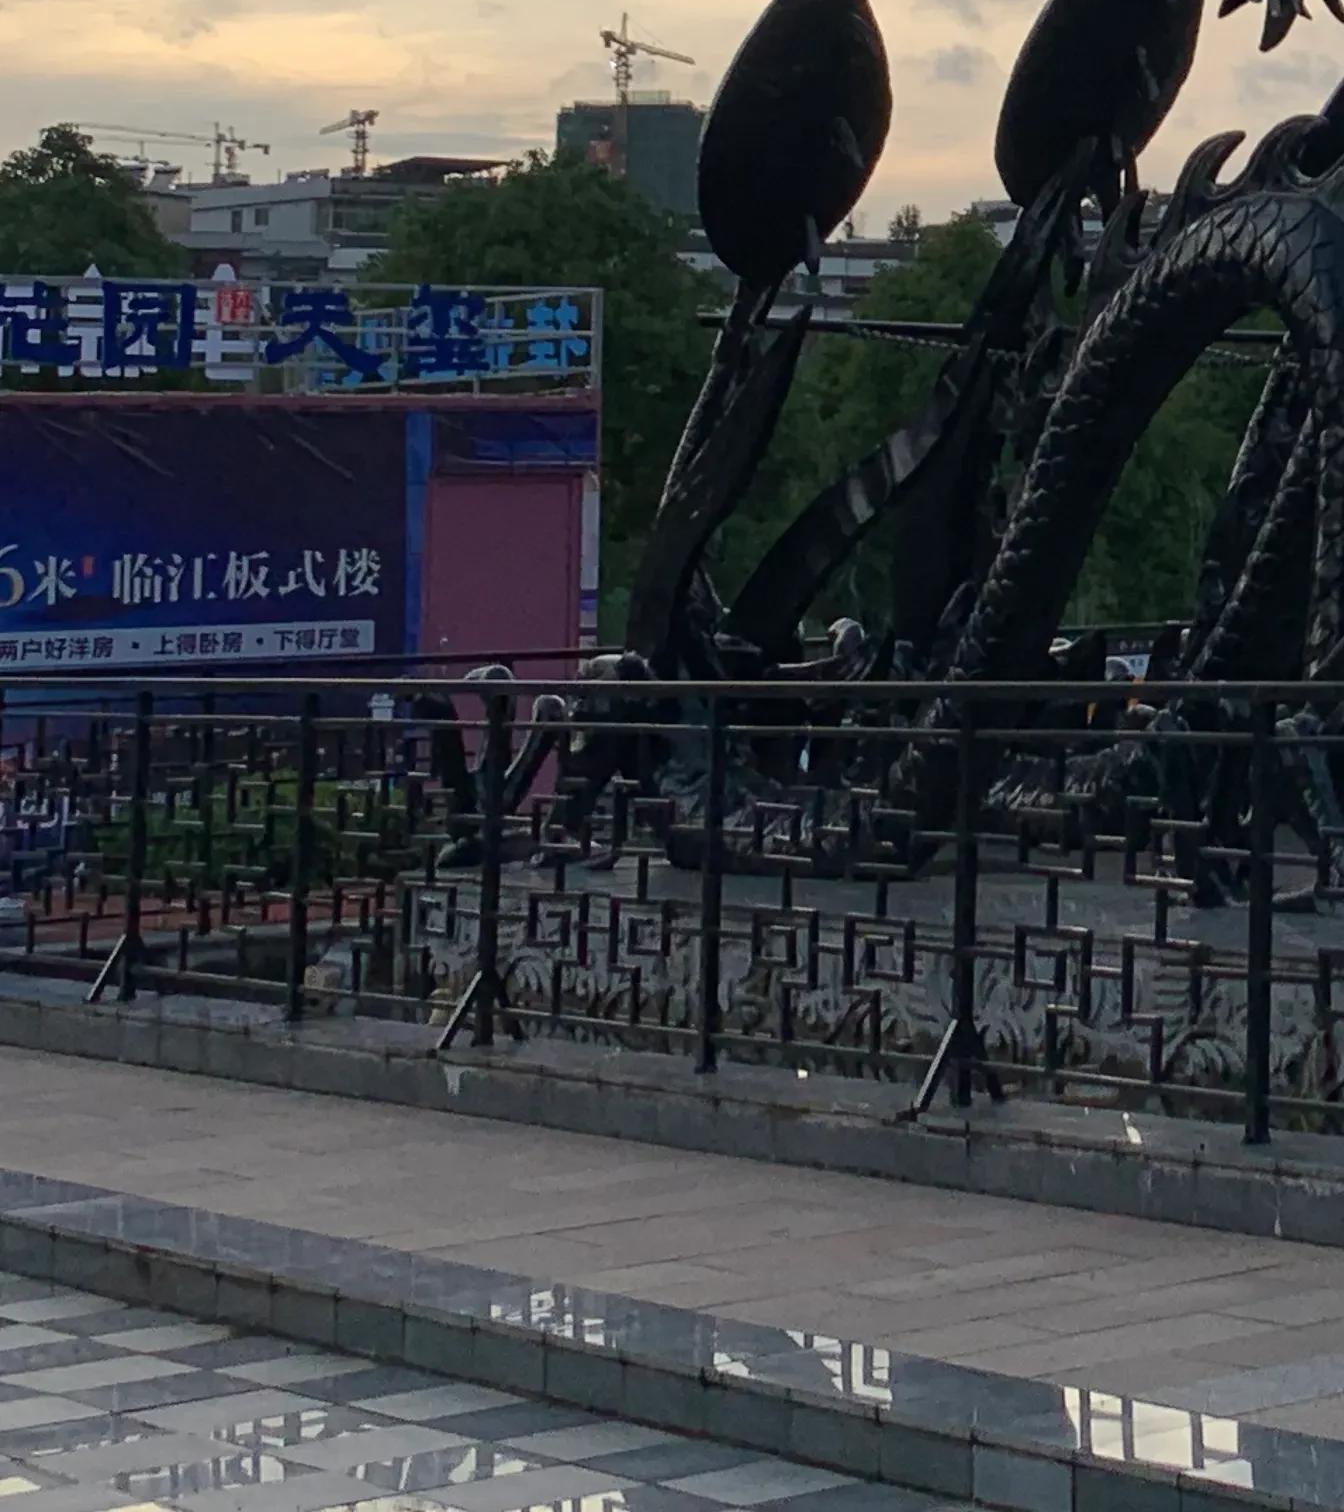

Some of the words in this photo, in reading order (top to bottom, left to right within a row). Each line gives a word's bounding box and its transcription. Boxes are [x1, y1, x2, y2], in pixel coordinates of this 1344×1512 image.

[112, 548, 381, 604] 临江板式楼
[153, 631, 243, 655] 上得卧房
[273, 627, 361, 651] 下得厅堂
